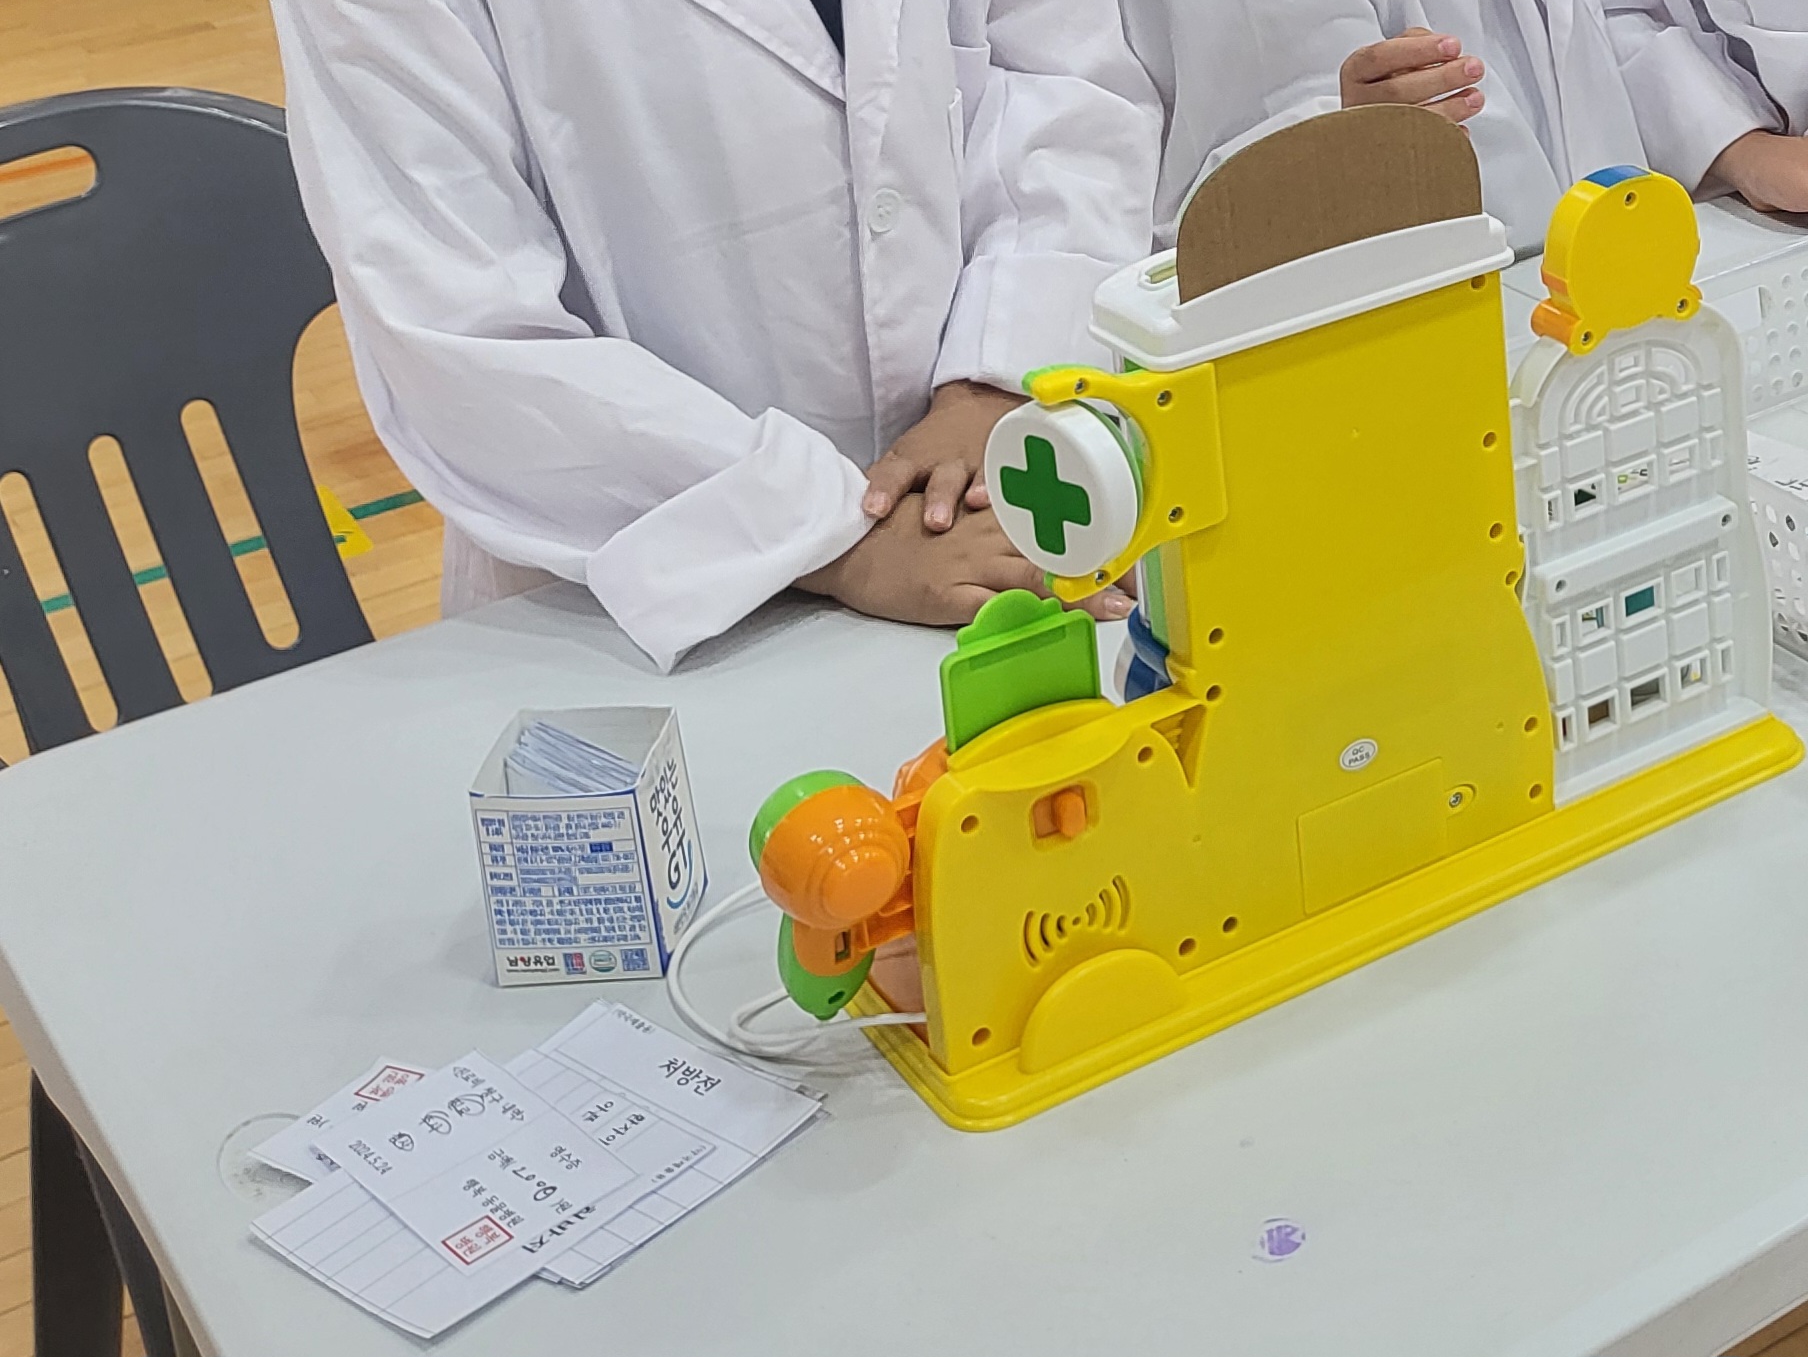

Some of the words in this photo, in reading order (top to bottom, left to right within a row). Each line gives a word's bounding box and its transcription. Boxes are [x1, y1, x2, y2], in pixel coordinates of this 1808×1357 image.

[1348, 751, 1370, 765] PASS
[1352, 745, 1365, 756] QC
[506, 954, 556, 967] 남양유업
[658, 1057, 722, 1097] 처방전
[598, 1112, 646, 1146] 환자이
[550, 1145, 583, 1171] 영수증
